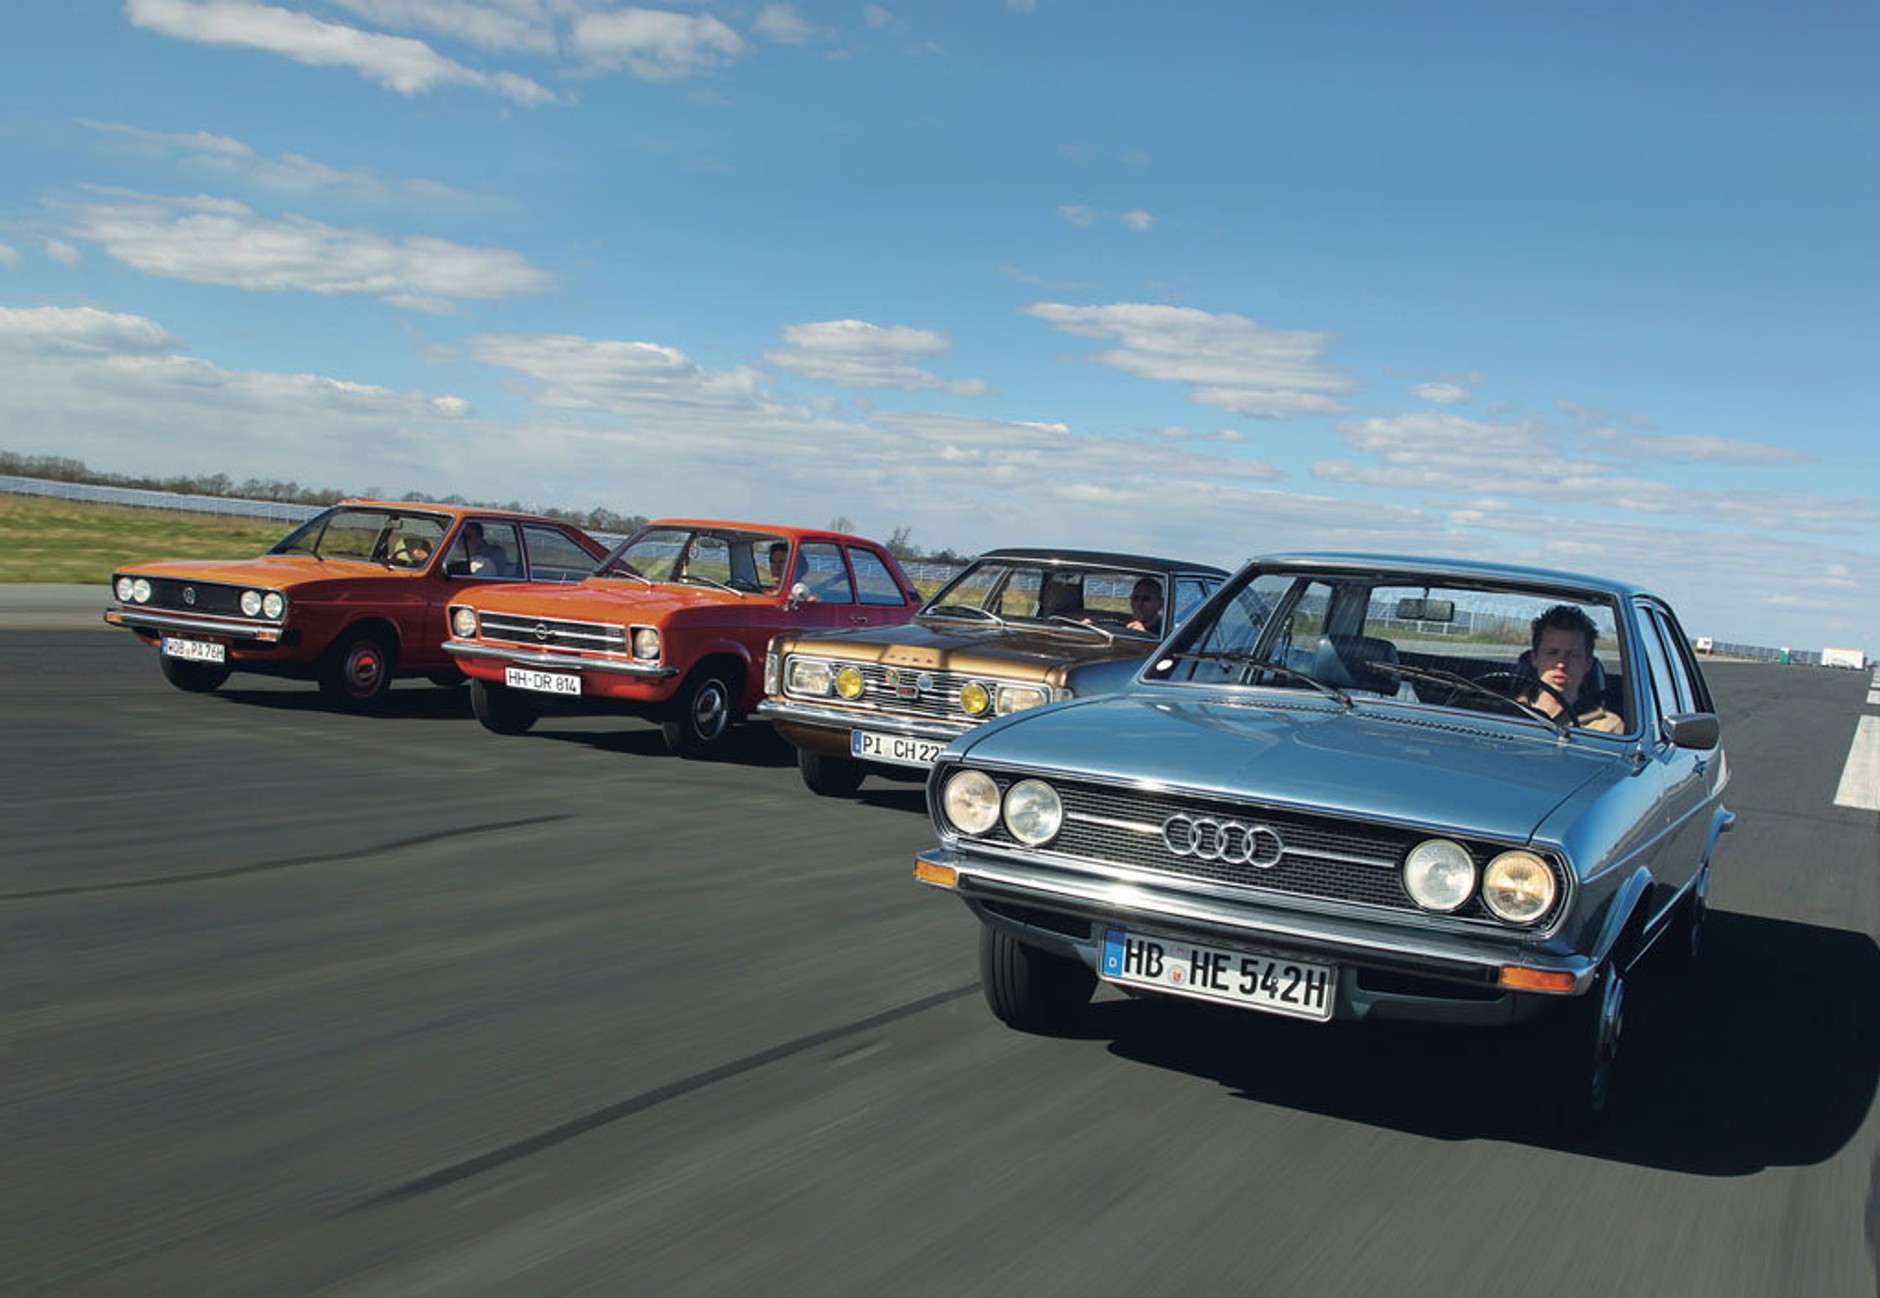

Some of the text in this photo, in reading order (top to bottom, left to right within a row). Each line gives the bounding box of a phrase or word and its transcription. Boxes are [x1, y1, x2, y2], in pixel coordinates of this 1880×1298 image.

[556, 676, 577, 693] 814
[862, 735, 945, 763] PI CH 22
[1124, 938, 1328, 1009] HB HE 542H
